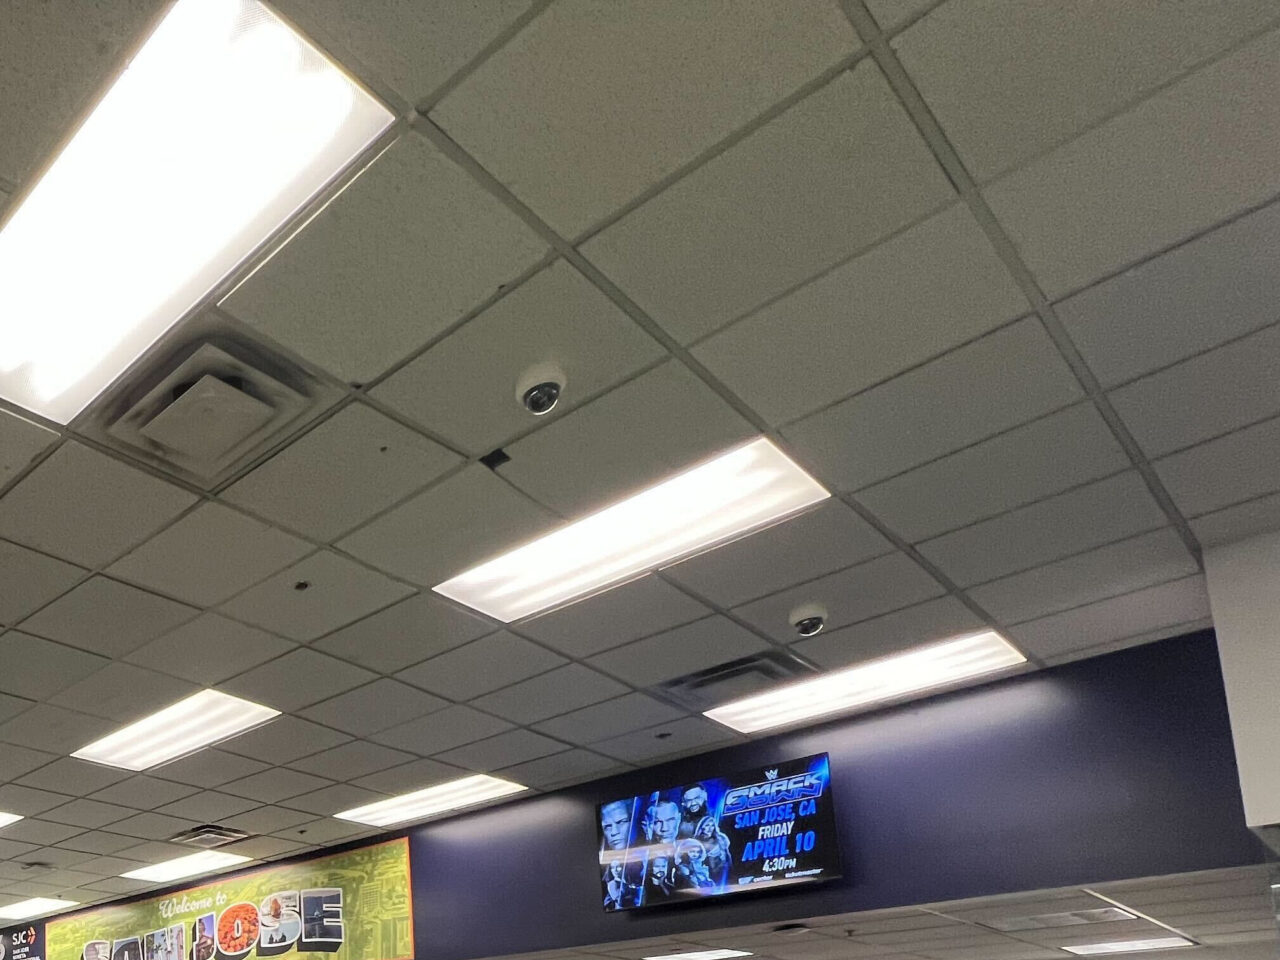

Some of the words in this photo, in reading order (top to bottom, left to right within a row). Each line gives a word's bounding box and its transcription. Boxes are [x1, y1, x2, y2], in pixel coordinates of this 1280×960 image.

[724, 783, 821, 813] DOWN
[726, 774, 821, 805] SMACK
[735, 810, 759, 828] SAN
[761, 804, 795, 823] JOSE,
[799, 799, 816, 816] CA
[758, 821, 794, 839] FRIDAY
[742, 836, 789, 862] APRIL
[796, 831, 815, 853] 10
[762, 858, 796, 872] 4:30PM
[159, 895, 212, 919] Welcome
[214, 892, 228, 906] to
[12, 931, 26, 945] SJC
